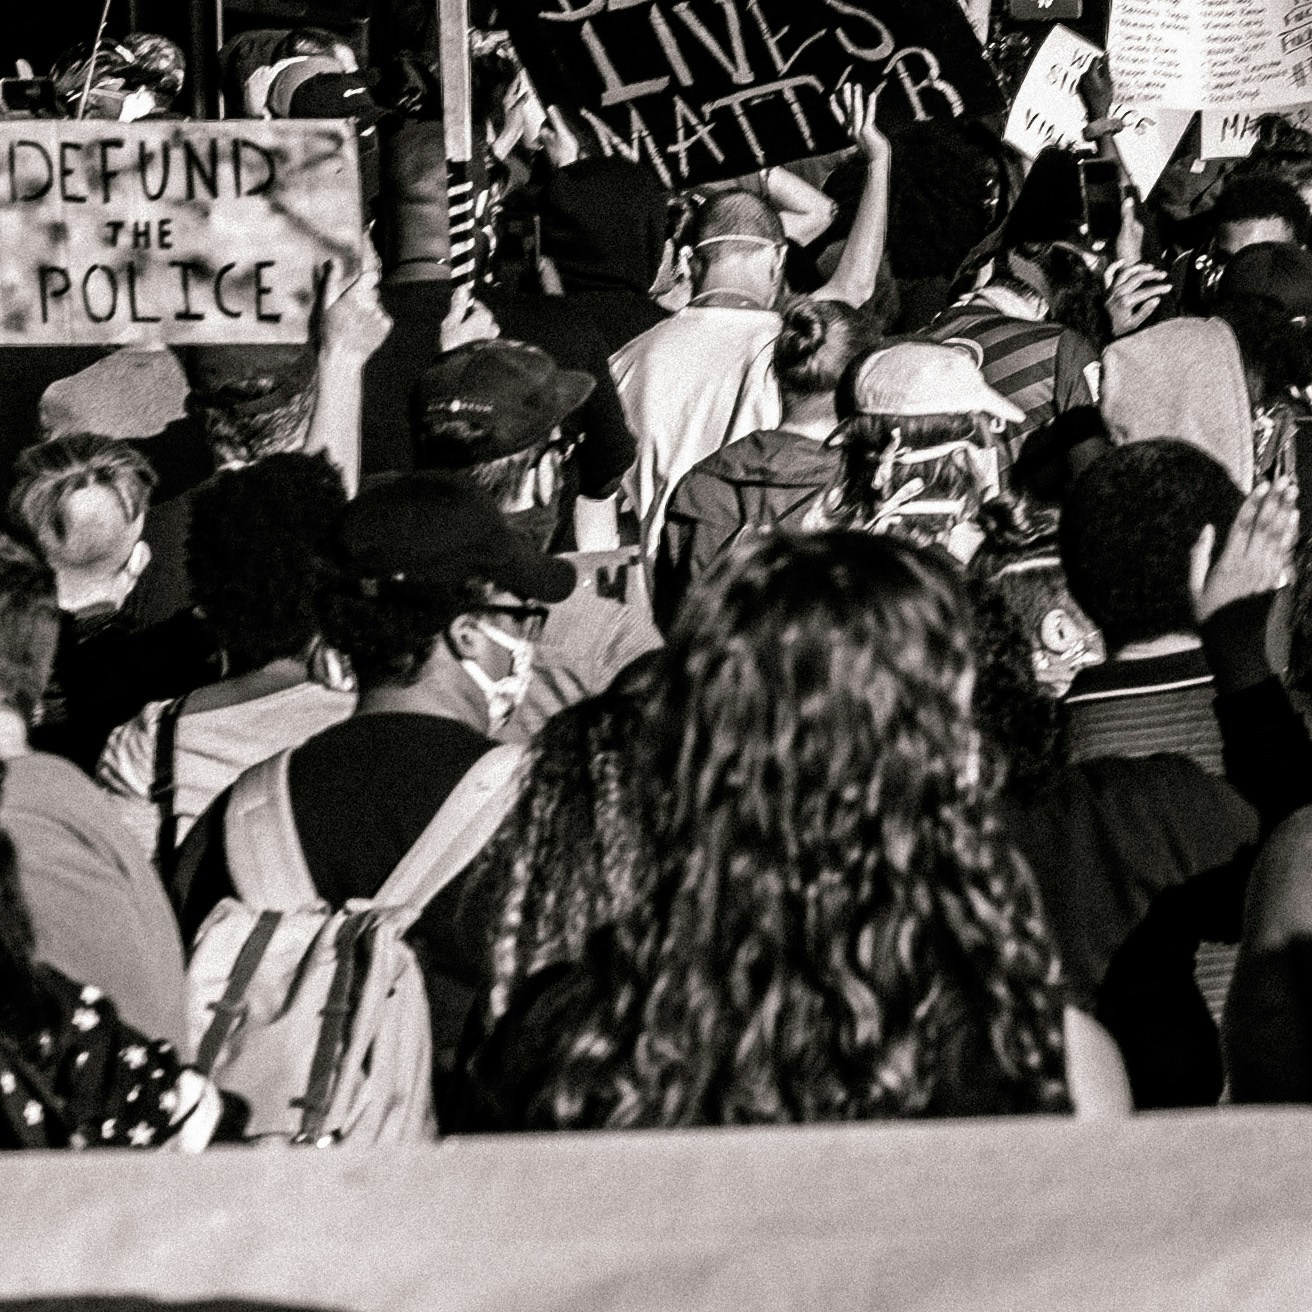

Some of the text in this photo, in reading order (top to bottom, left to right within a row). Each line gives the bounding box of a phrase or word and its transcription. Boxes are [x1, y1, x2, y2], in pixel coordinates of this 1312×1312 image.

[9, 137, 277, 204] DEFUND
[105, 218, 174, 250] THE
[38, 259, 282, 324] POLICE
